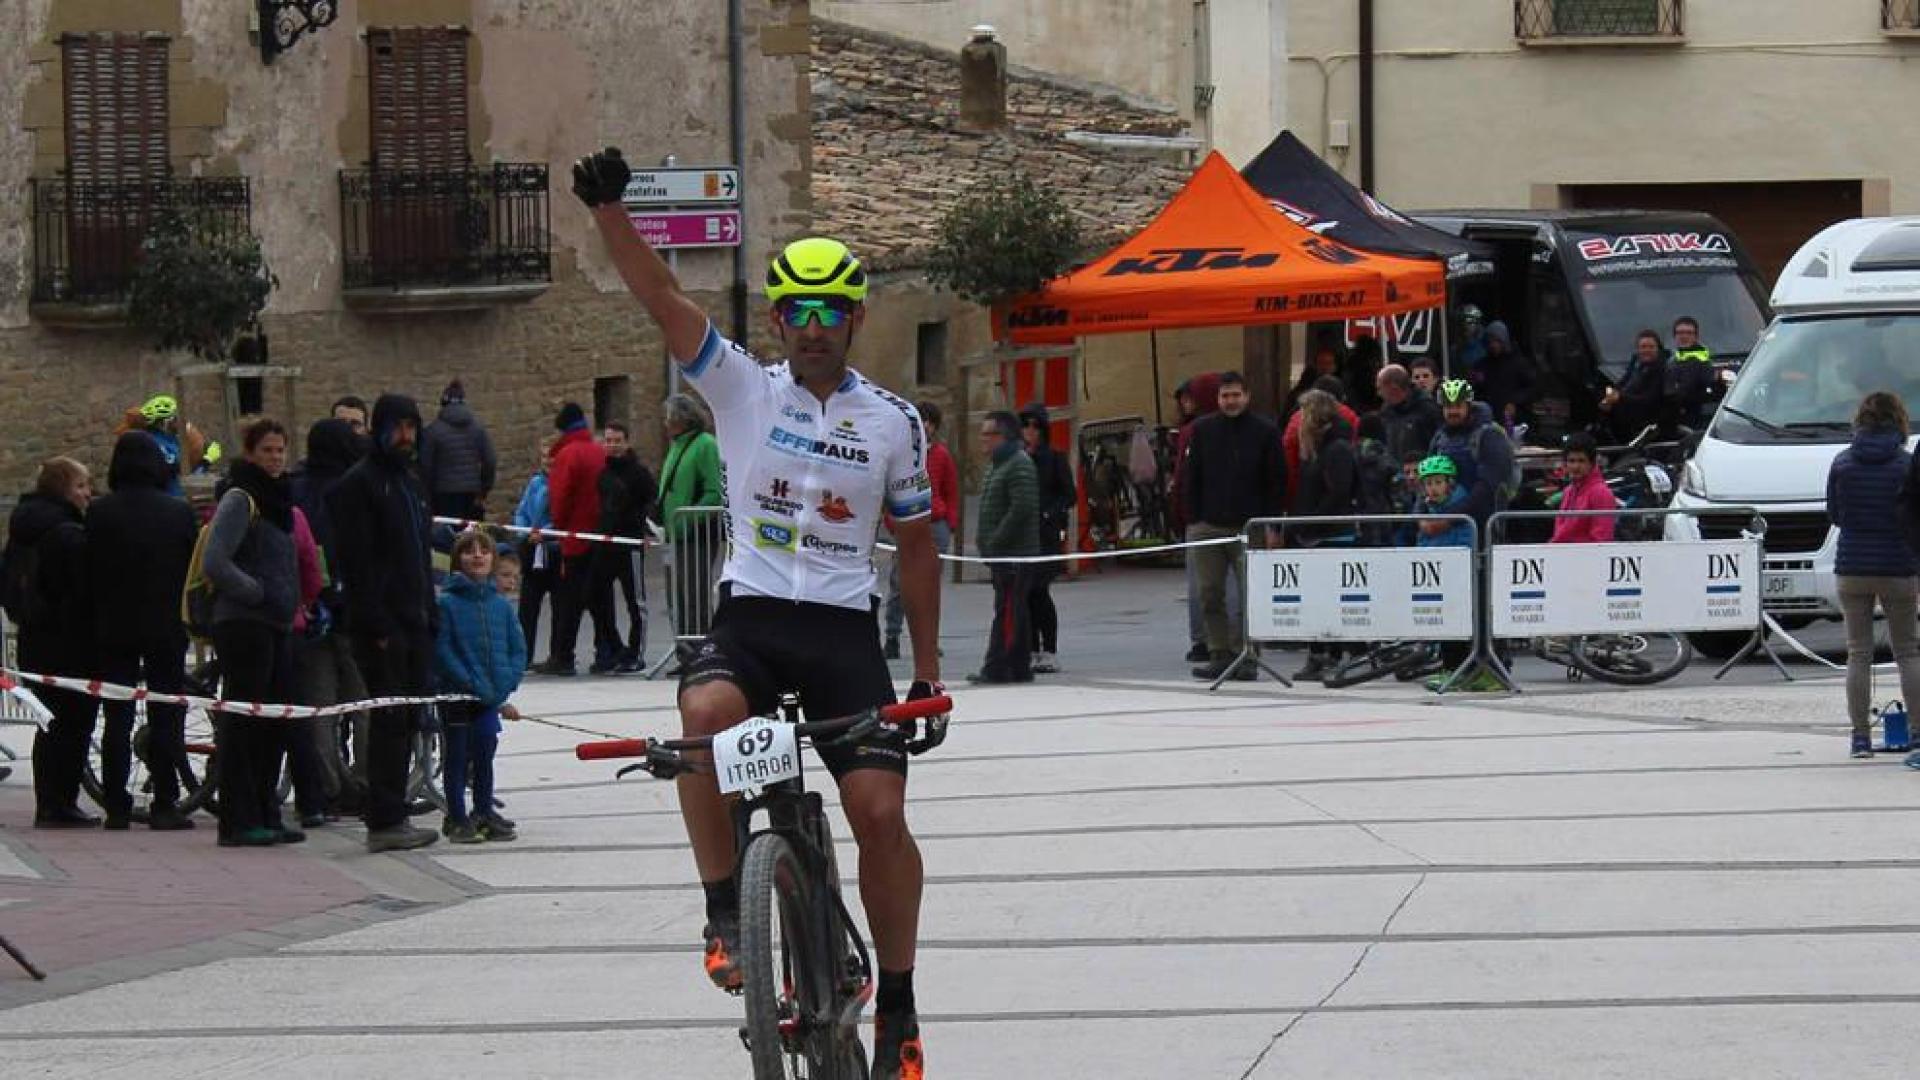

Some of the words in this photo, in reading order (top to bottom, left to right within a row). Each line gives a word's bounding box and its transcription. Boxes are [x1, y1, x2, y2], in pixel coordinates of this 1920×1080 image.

[1102, 247, 1281, 277] KTM
[1255, 290, 1366, 312] KTM-BIKES.AT
[1009, 304, 1069, 328] KTM
[1272, 563, 1301, 589] DN
[1341, 562, 1369, 588] DN
[1411, 561, 1442, 588] DN
[1511, 558, 1545, 585] DN
[1608, 556, 1643, 582] DN
[1706, 553, 1740, 581] DN
[737, 728, 775, 757] 69
[727, 753, 792, 785] ITAROA
